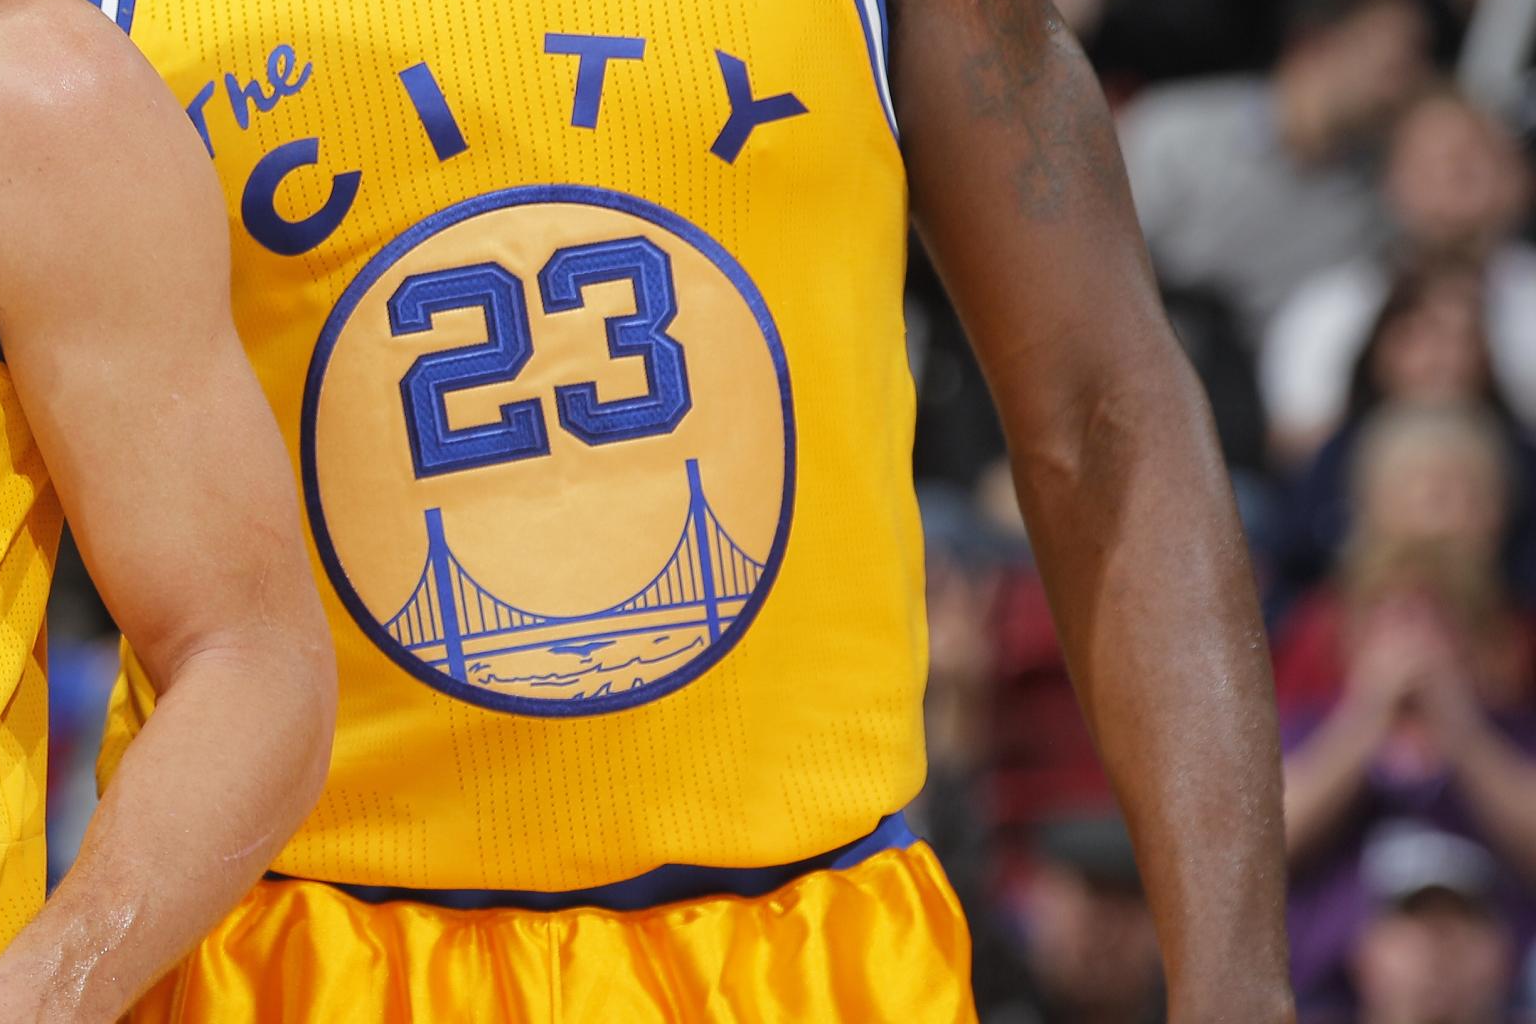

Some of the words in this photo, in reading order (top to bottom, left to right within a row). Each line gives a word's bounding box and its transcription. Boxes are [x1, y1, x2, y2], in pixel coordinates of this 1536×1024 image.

[186, 43, 313, 160] The
[241, 32, 810, 256] CITY
[387, 235, 693, 480] 23
